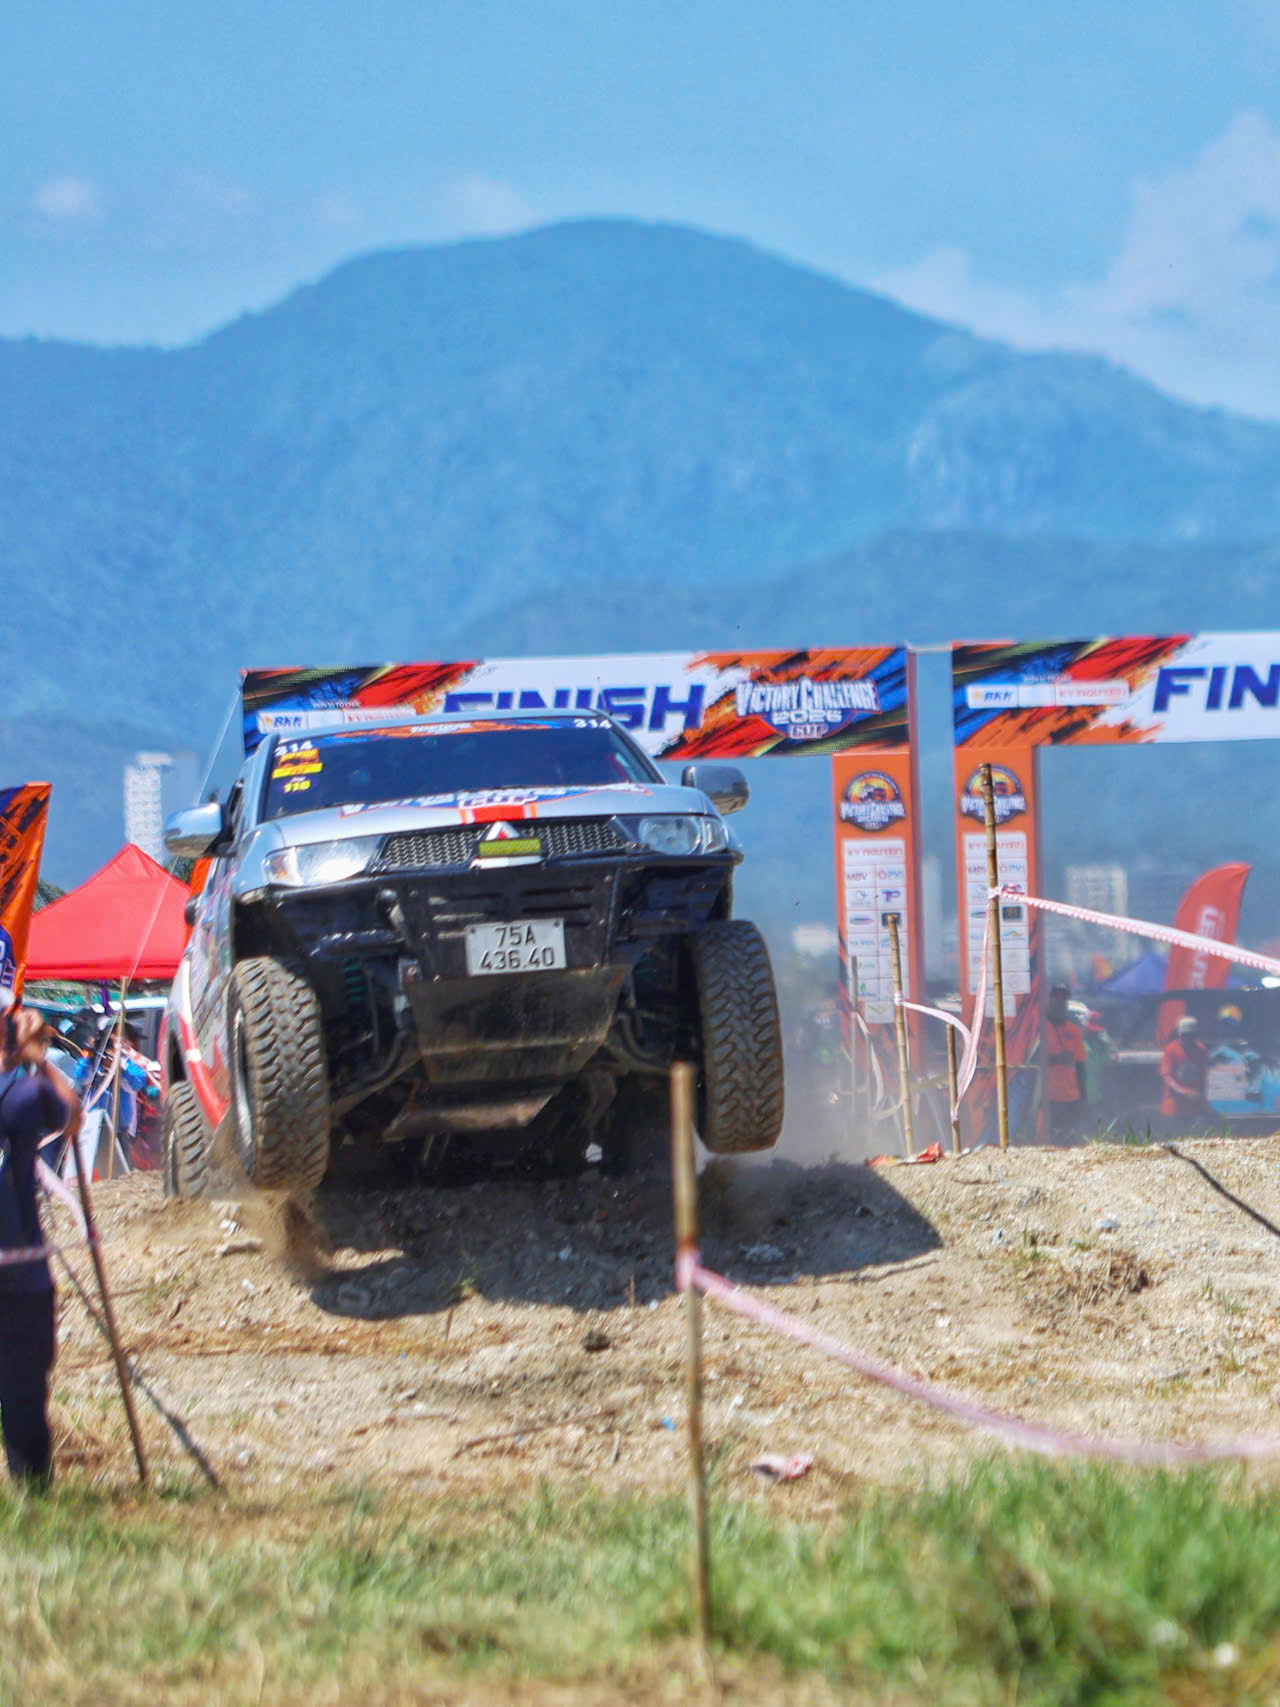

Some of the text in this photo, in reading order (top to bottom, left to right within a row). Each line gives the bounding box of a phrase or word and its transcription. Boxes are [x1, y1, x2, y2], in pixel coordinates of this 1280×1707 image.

[736, 677, 881, 717] VICTORY CHALLENGE
[573, 718, 612, 728] 314
[771, 709, 842, 725] 2026
[789, 723, 829, 739] CUP
[274, 740, 313, 756] 314
[495, 925, 536, 947] 75A
[480, 947, 555, 970] 436.40
